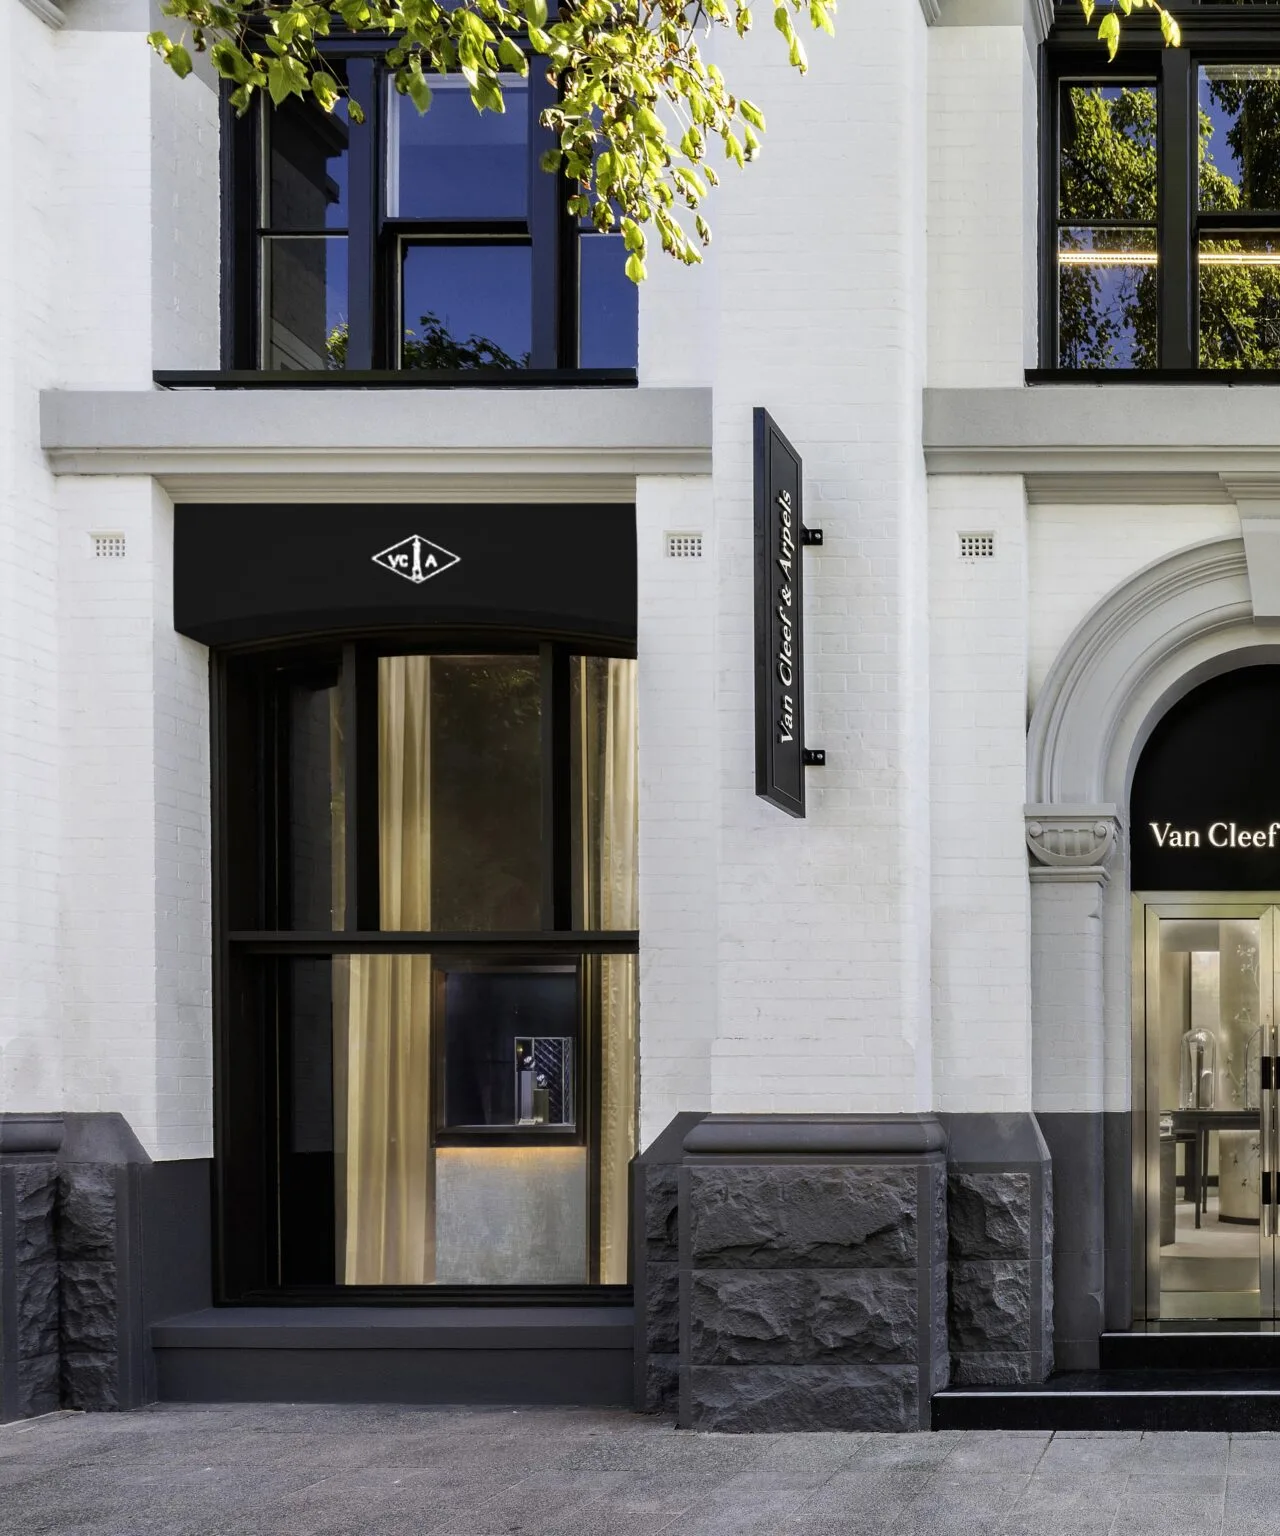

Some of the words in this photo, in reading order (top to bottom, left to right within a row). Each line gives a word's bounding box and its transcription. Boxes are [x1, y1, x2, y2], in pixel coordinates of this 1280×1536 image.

[779, 489, 795, 582] Arpels
[781, 584, 792, 607] &
[779, 605, 793, 688] Cleef
[781, 694, 794, 744] Van
[1149, 823, 1200, 848] Van
[1207, 822, 1280, 848] Cleef
